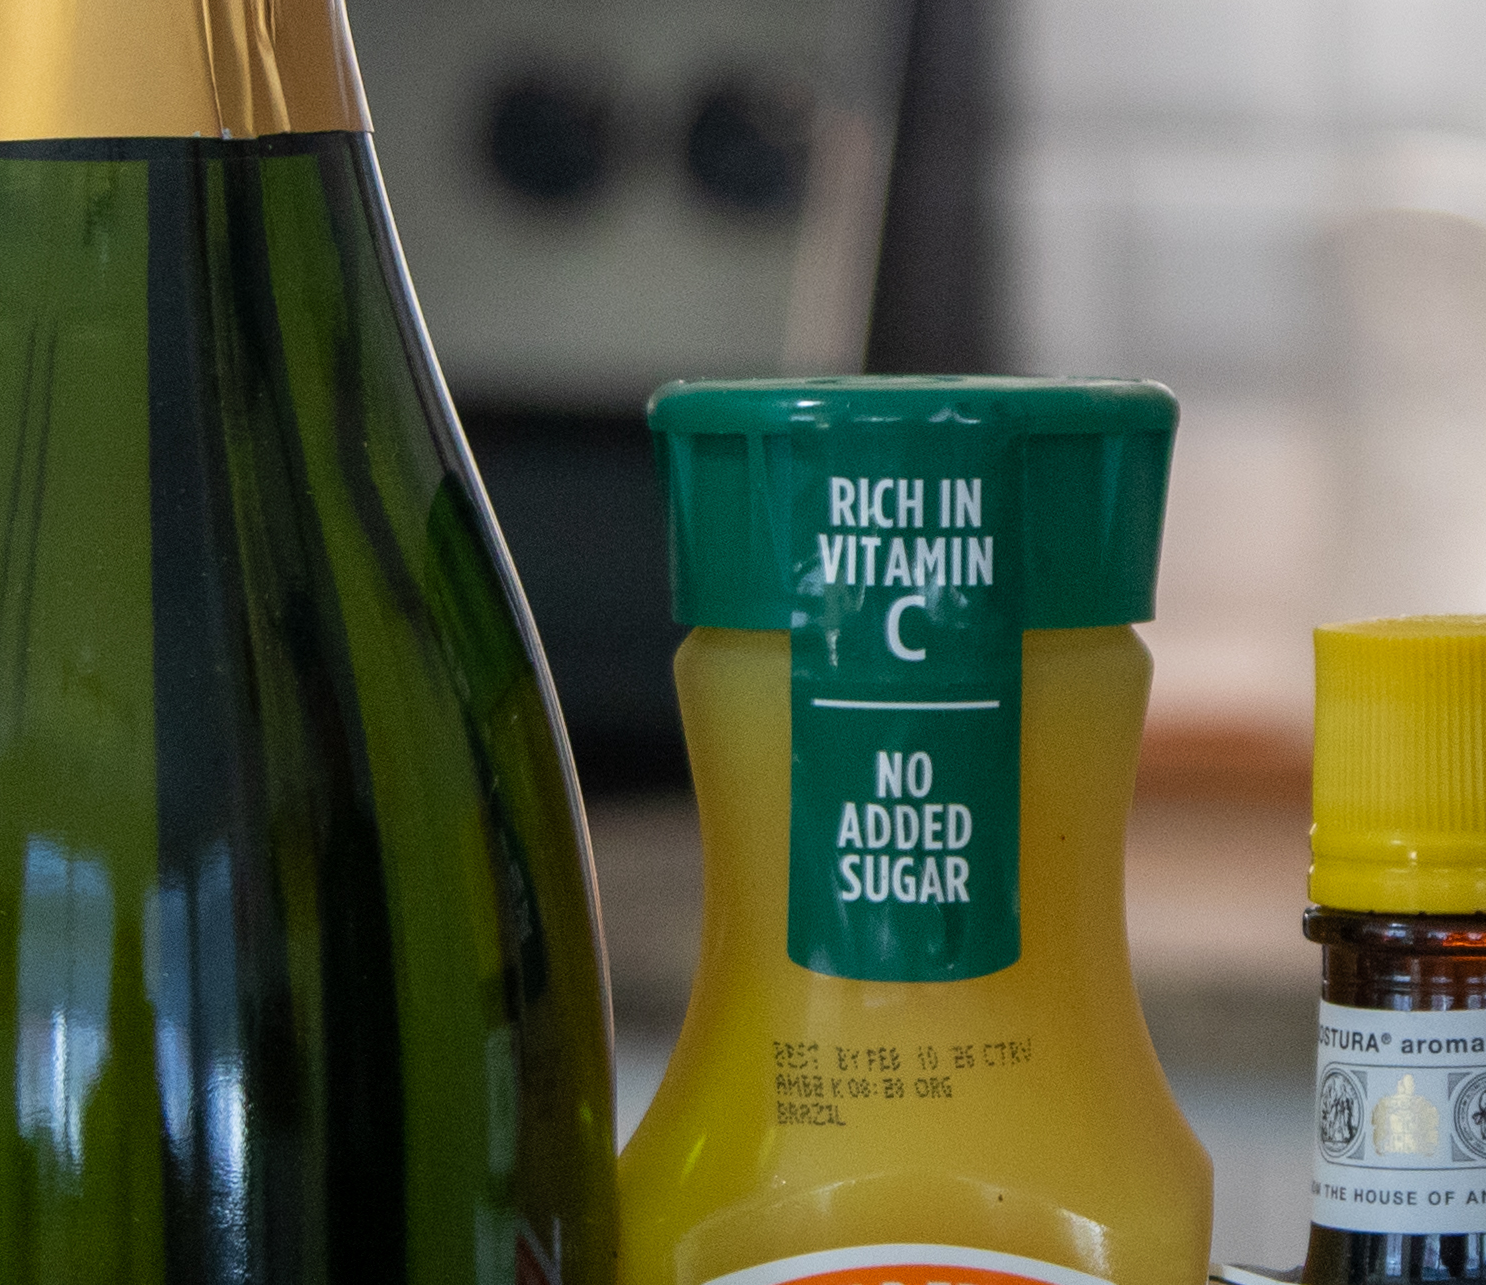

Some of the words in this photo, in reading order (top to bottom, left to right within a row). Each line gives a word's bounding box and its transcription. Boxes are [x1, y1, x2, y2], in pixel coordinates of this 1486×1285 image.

[829, 477, 923, 528] RICH
[940, 478, 982, 528] IN
[818, 534, 994, 586] VITAMIN
[886, 596, 927, 661] C
[876, 750, 933, 799] NO
[838, 804, 973, 851] ADDED
[840, 855, 971, 904] SUGAR
[1324, 1183, 1347, 1202] THE
[1354, 1188, 1418, 1206] HOUSE
[1428, 1190, 1456, 1206] OF
